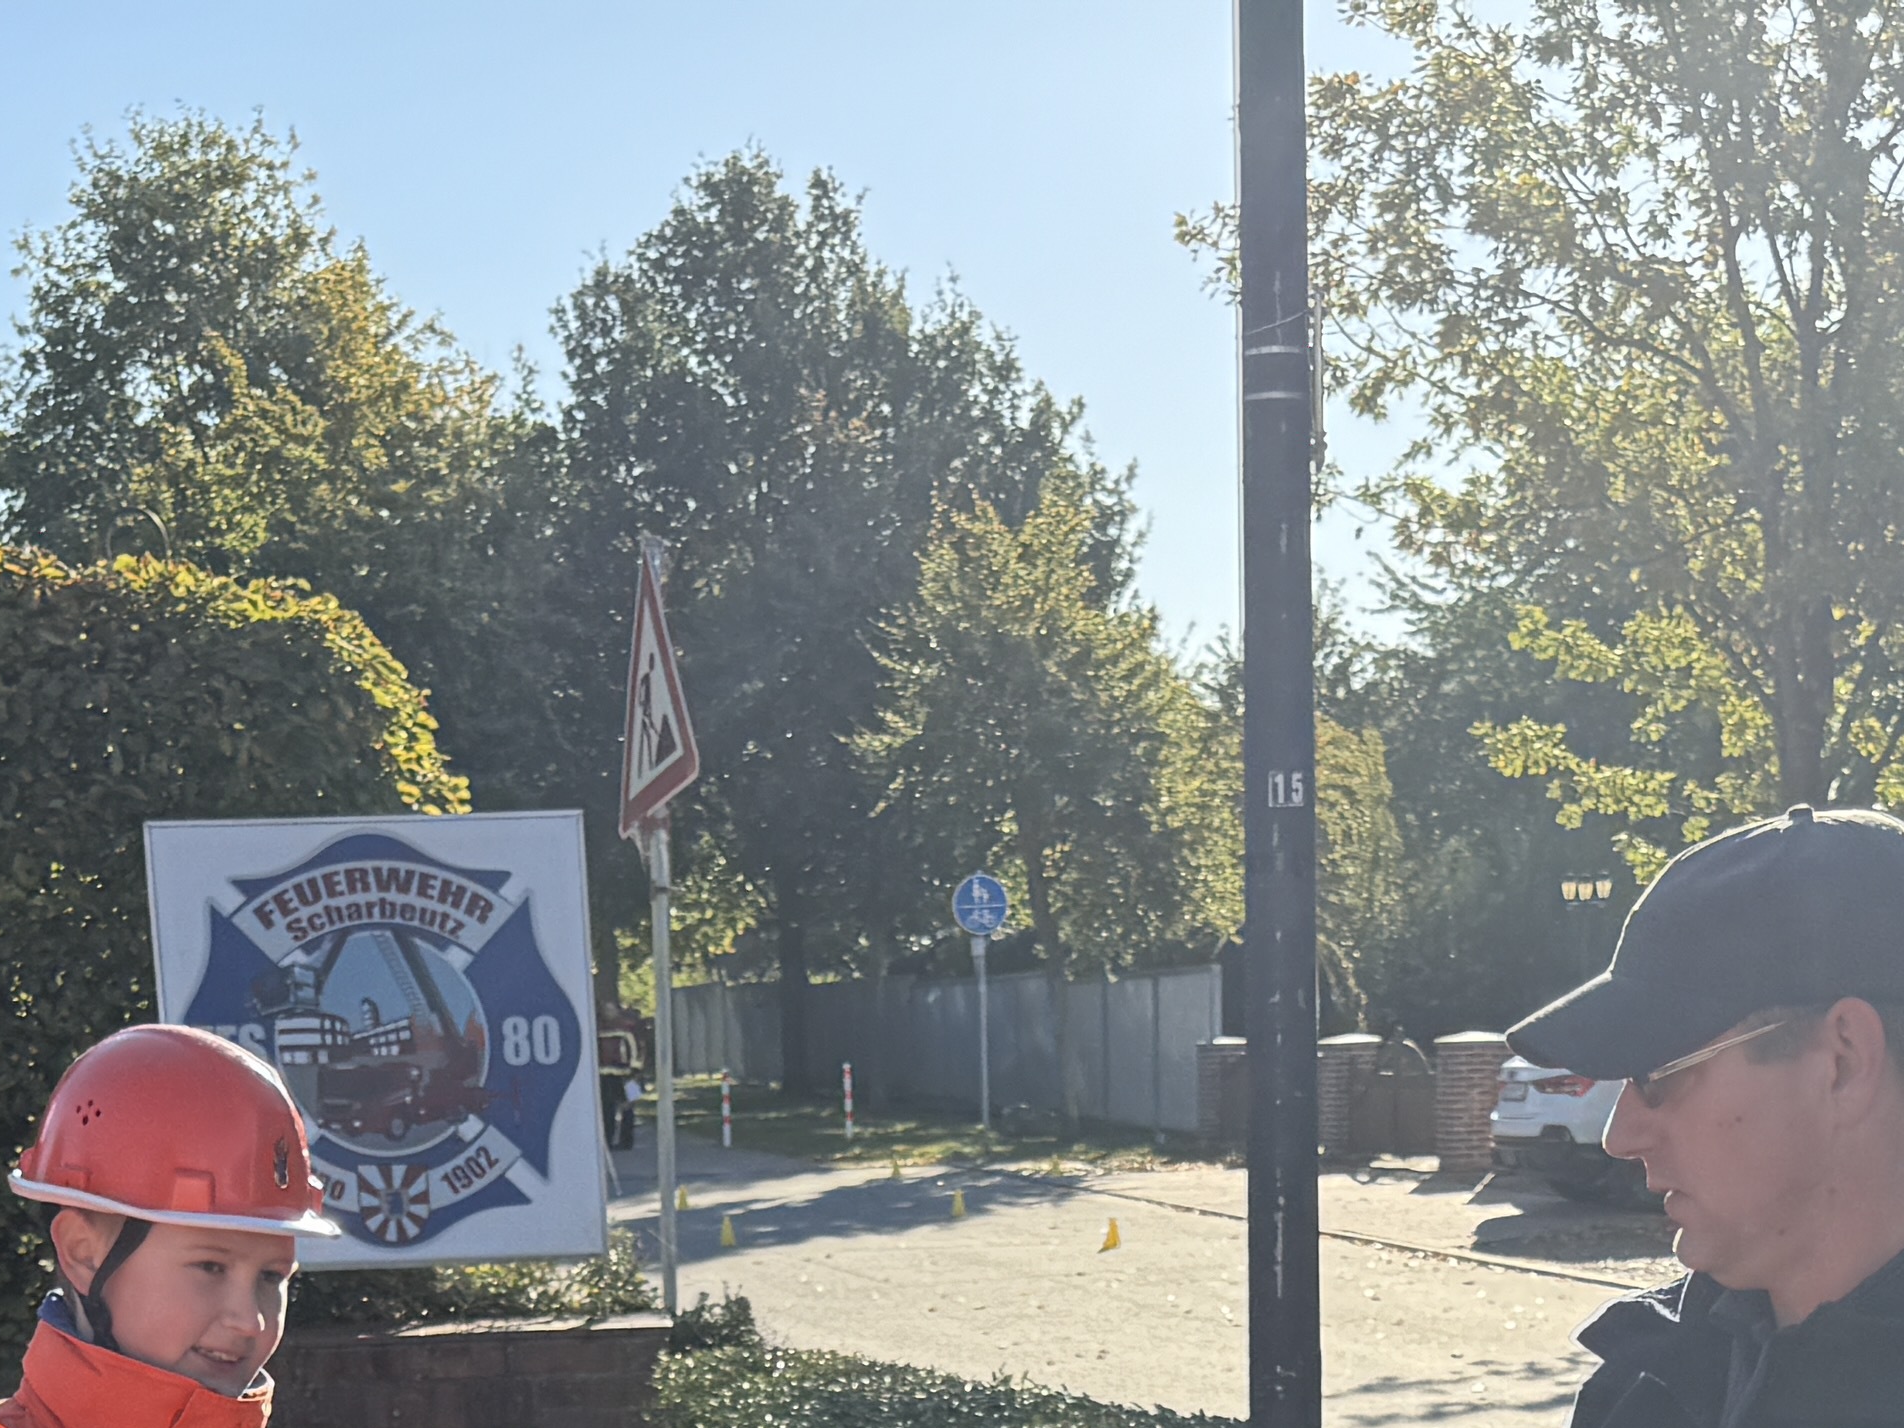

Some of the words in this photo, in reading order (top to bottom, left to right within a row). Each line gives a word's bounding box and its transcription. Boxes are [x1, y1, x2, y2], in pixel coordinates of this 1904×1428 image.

[1274, 772, 1303, 804] 15
[252, 866, 495, 931] FEUERWEHR
[285, 897, 466, 943] Scharbeutz
[501, 1014, 561, 1067] 80
[440, 1145, 500, 1195] 1902
